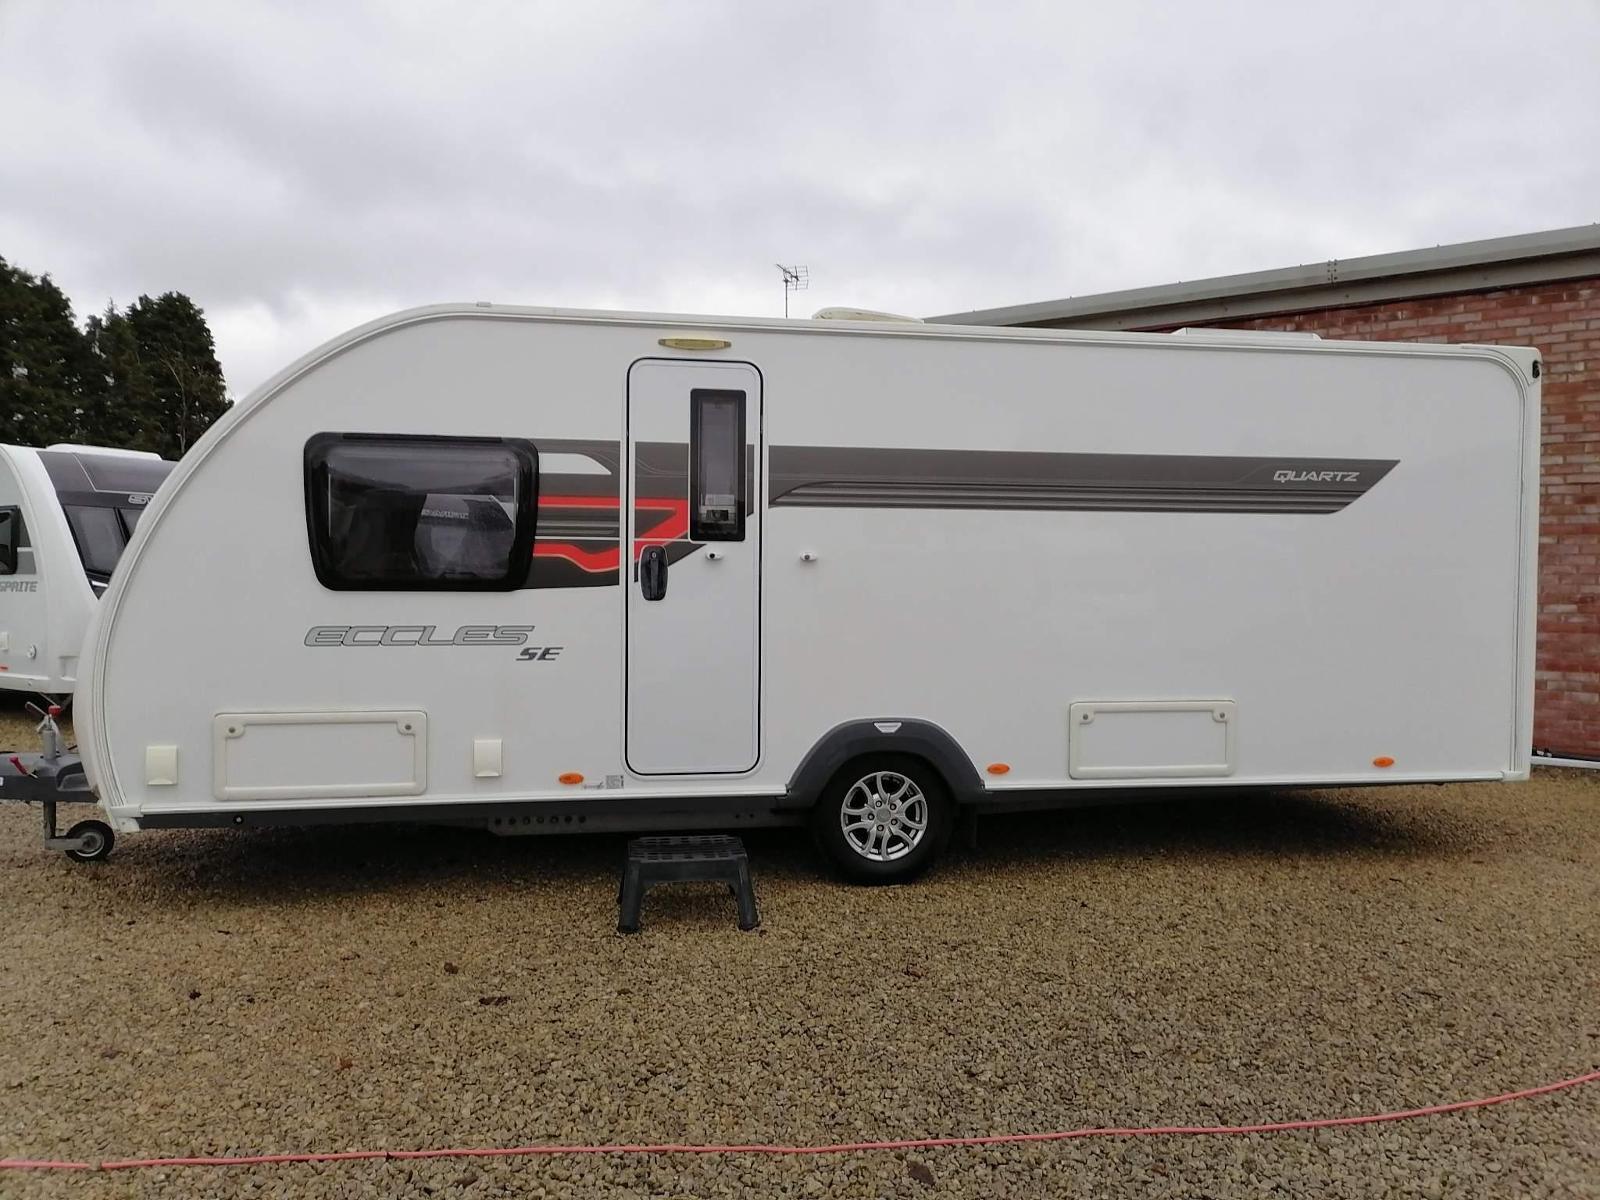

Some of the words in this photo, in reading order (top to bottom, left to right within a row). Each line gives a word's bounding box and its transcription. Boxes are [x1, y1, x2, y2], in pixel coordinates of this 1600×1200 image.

[1273, 470, 1360, 483] QUARTZ
[304, 625, 535, 646] ECCLES
[515, 647, 564, 661] SE
